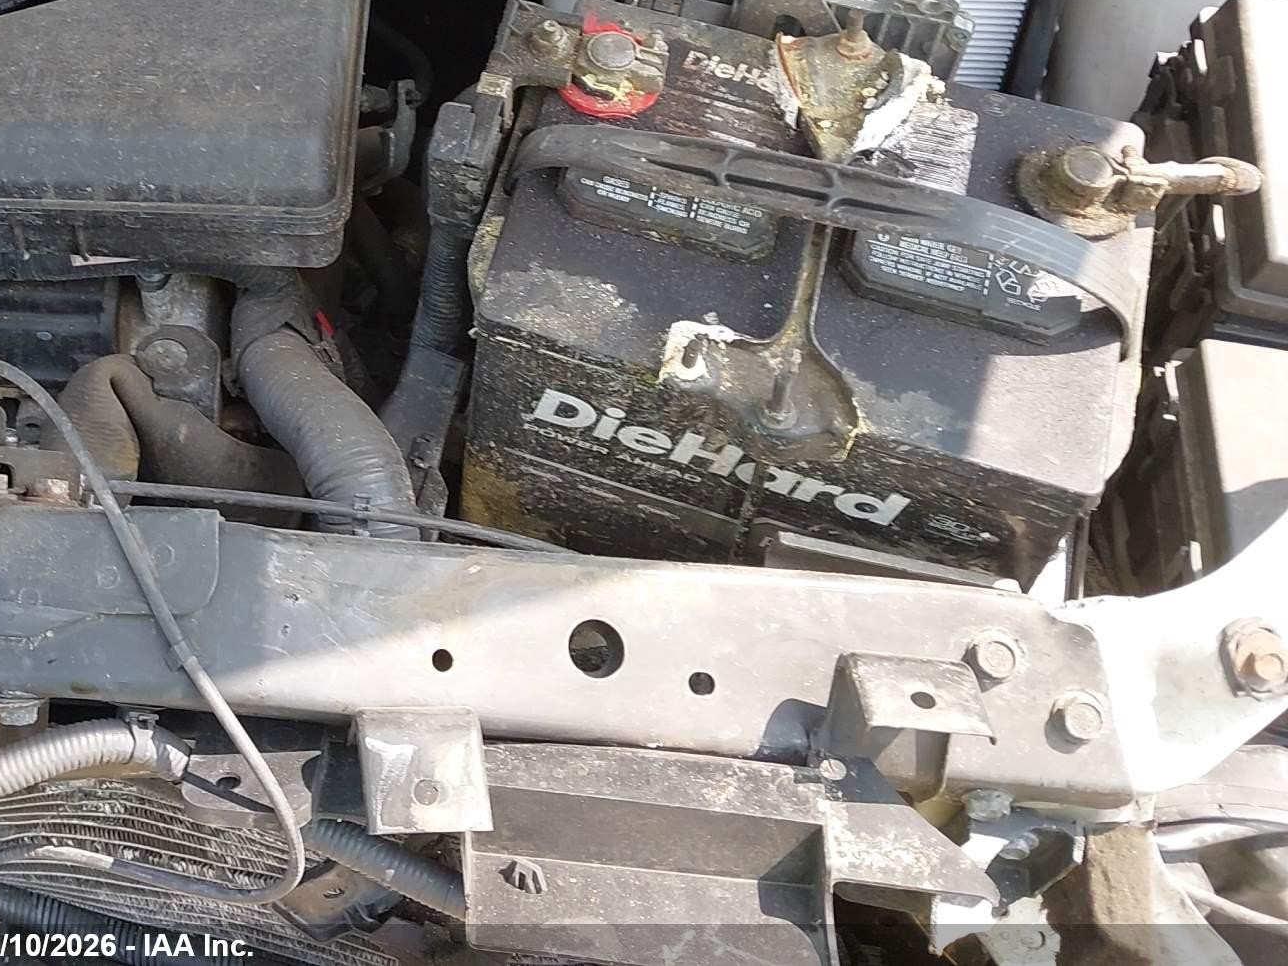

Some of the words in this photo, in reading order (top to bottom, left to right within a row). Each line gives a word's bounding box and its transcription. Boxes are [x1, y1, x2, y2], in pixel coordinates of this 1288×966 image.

[524, 423, 609, 455] POWER
[616, 452, 702, 483] AHEAD
[533, 389, 911, 526] DieHard
